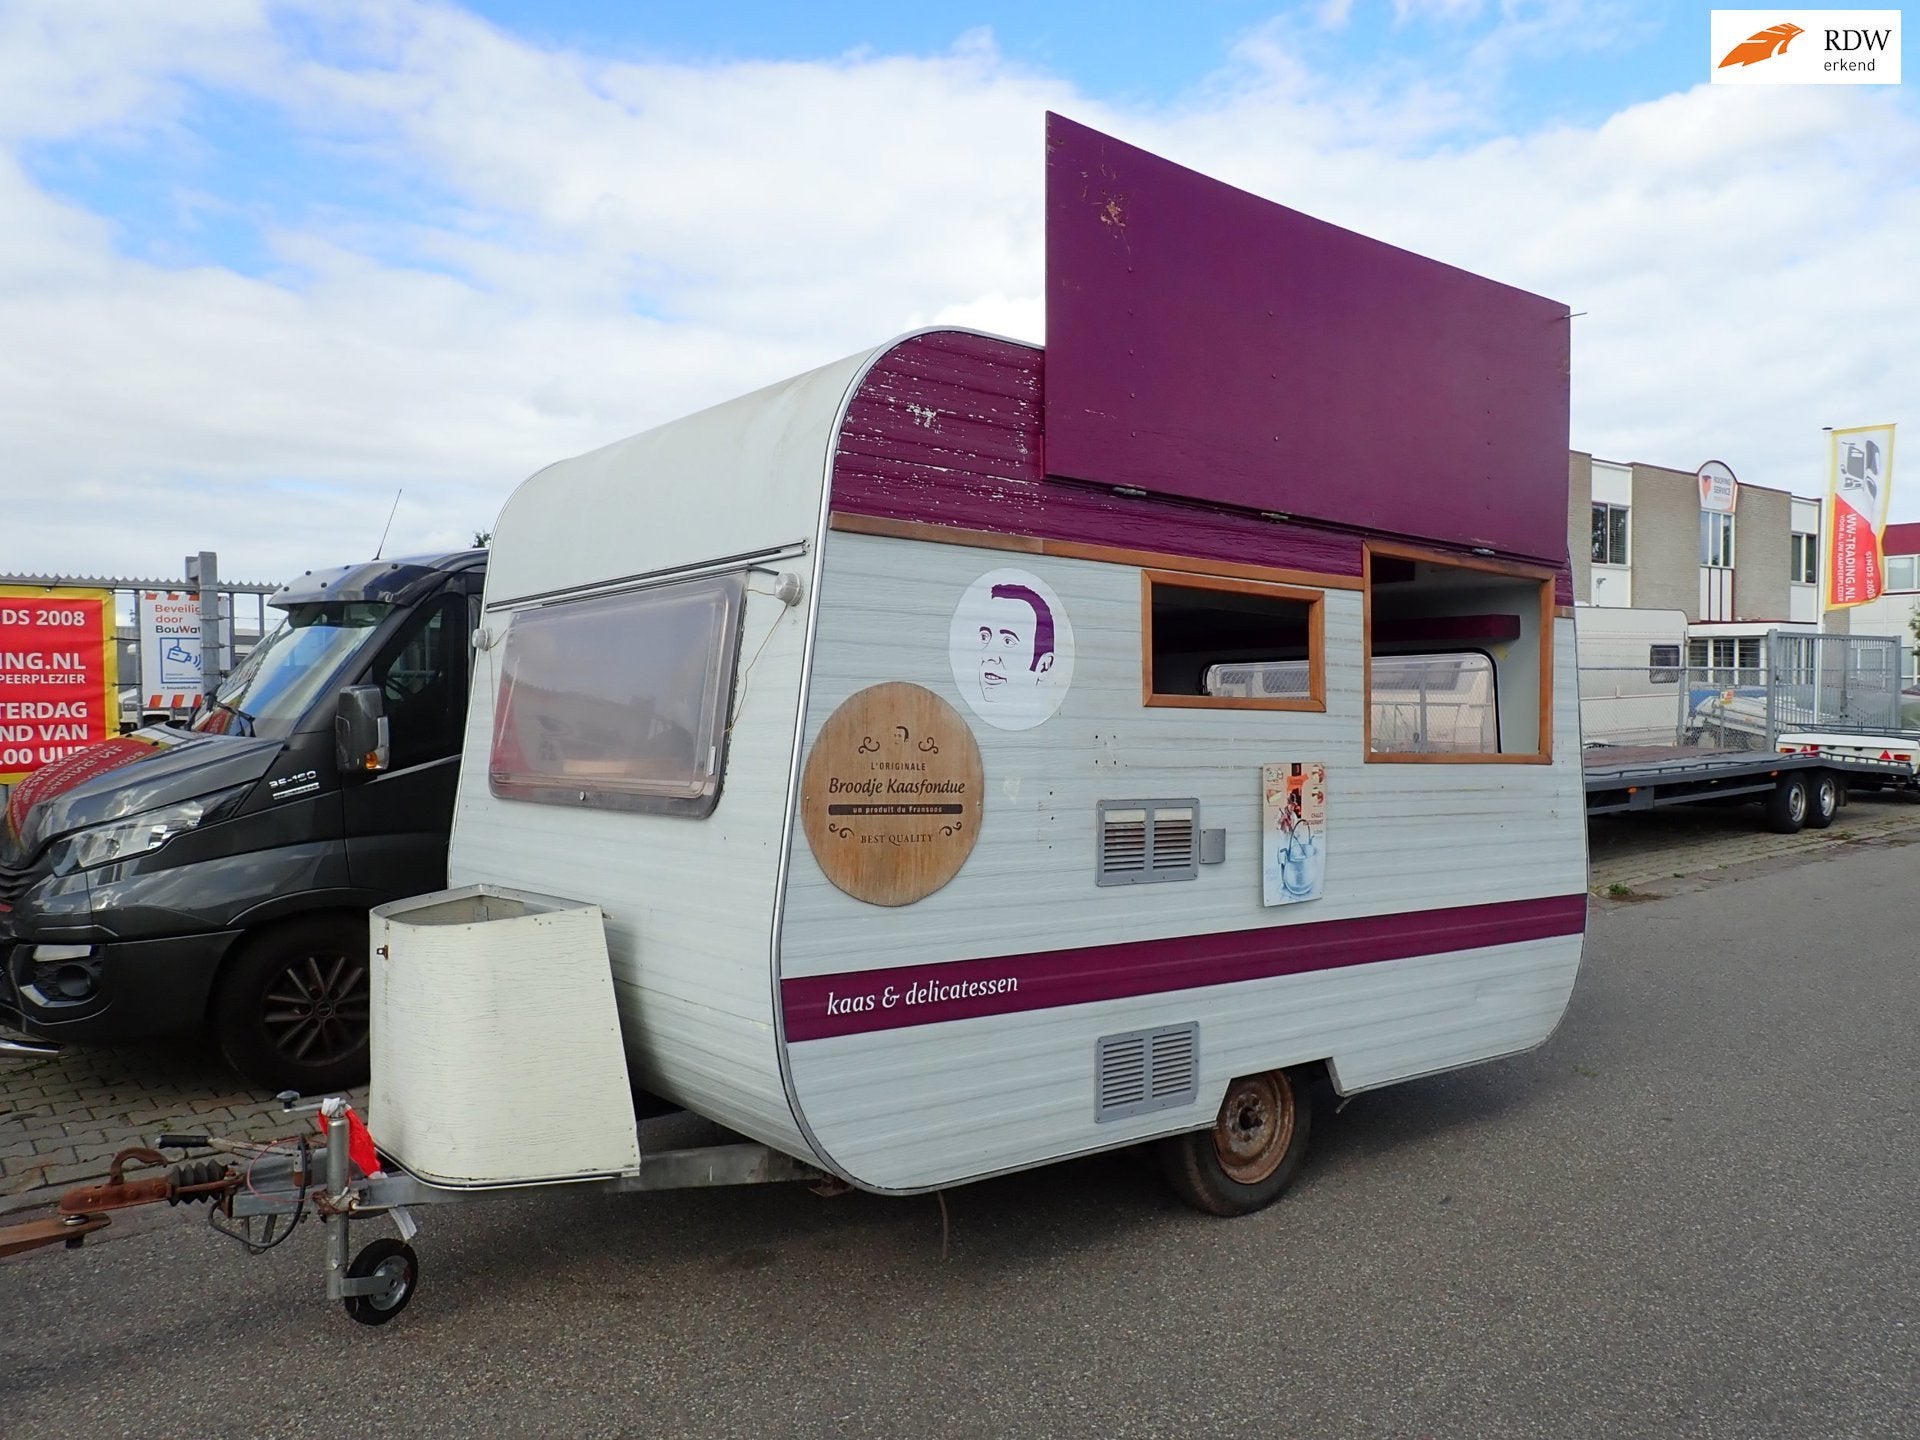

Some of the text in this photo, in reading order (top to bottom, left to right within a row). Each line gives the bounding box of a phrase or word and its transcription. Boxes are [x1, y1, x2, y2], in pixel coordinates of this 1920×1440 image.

[1845, 513, 1857, 602] WW-TRADING.NL
[1865, 551, 1874, 578] SINDS
[2, 609, 85, 626] DS 2008
[155, 616, 183, 624] door
[0, 674, 86, 685] PEERPLEZIER
[0, 724, 88, 742] ND VAN
[39, 746, 87, 764] UU
[871, 762, 926, 771] L'ORIGINALE
[828, 777, 965, 796] Broodje Kaasfondue
[865, 806, 894, 814] produit
[861, 834, 934, 846] BEST QUALITY
[827, 977, 1018, 1015] kaas & delicatessen
